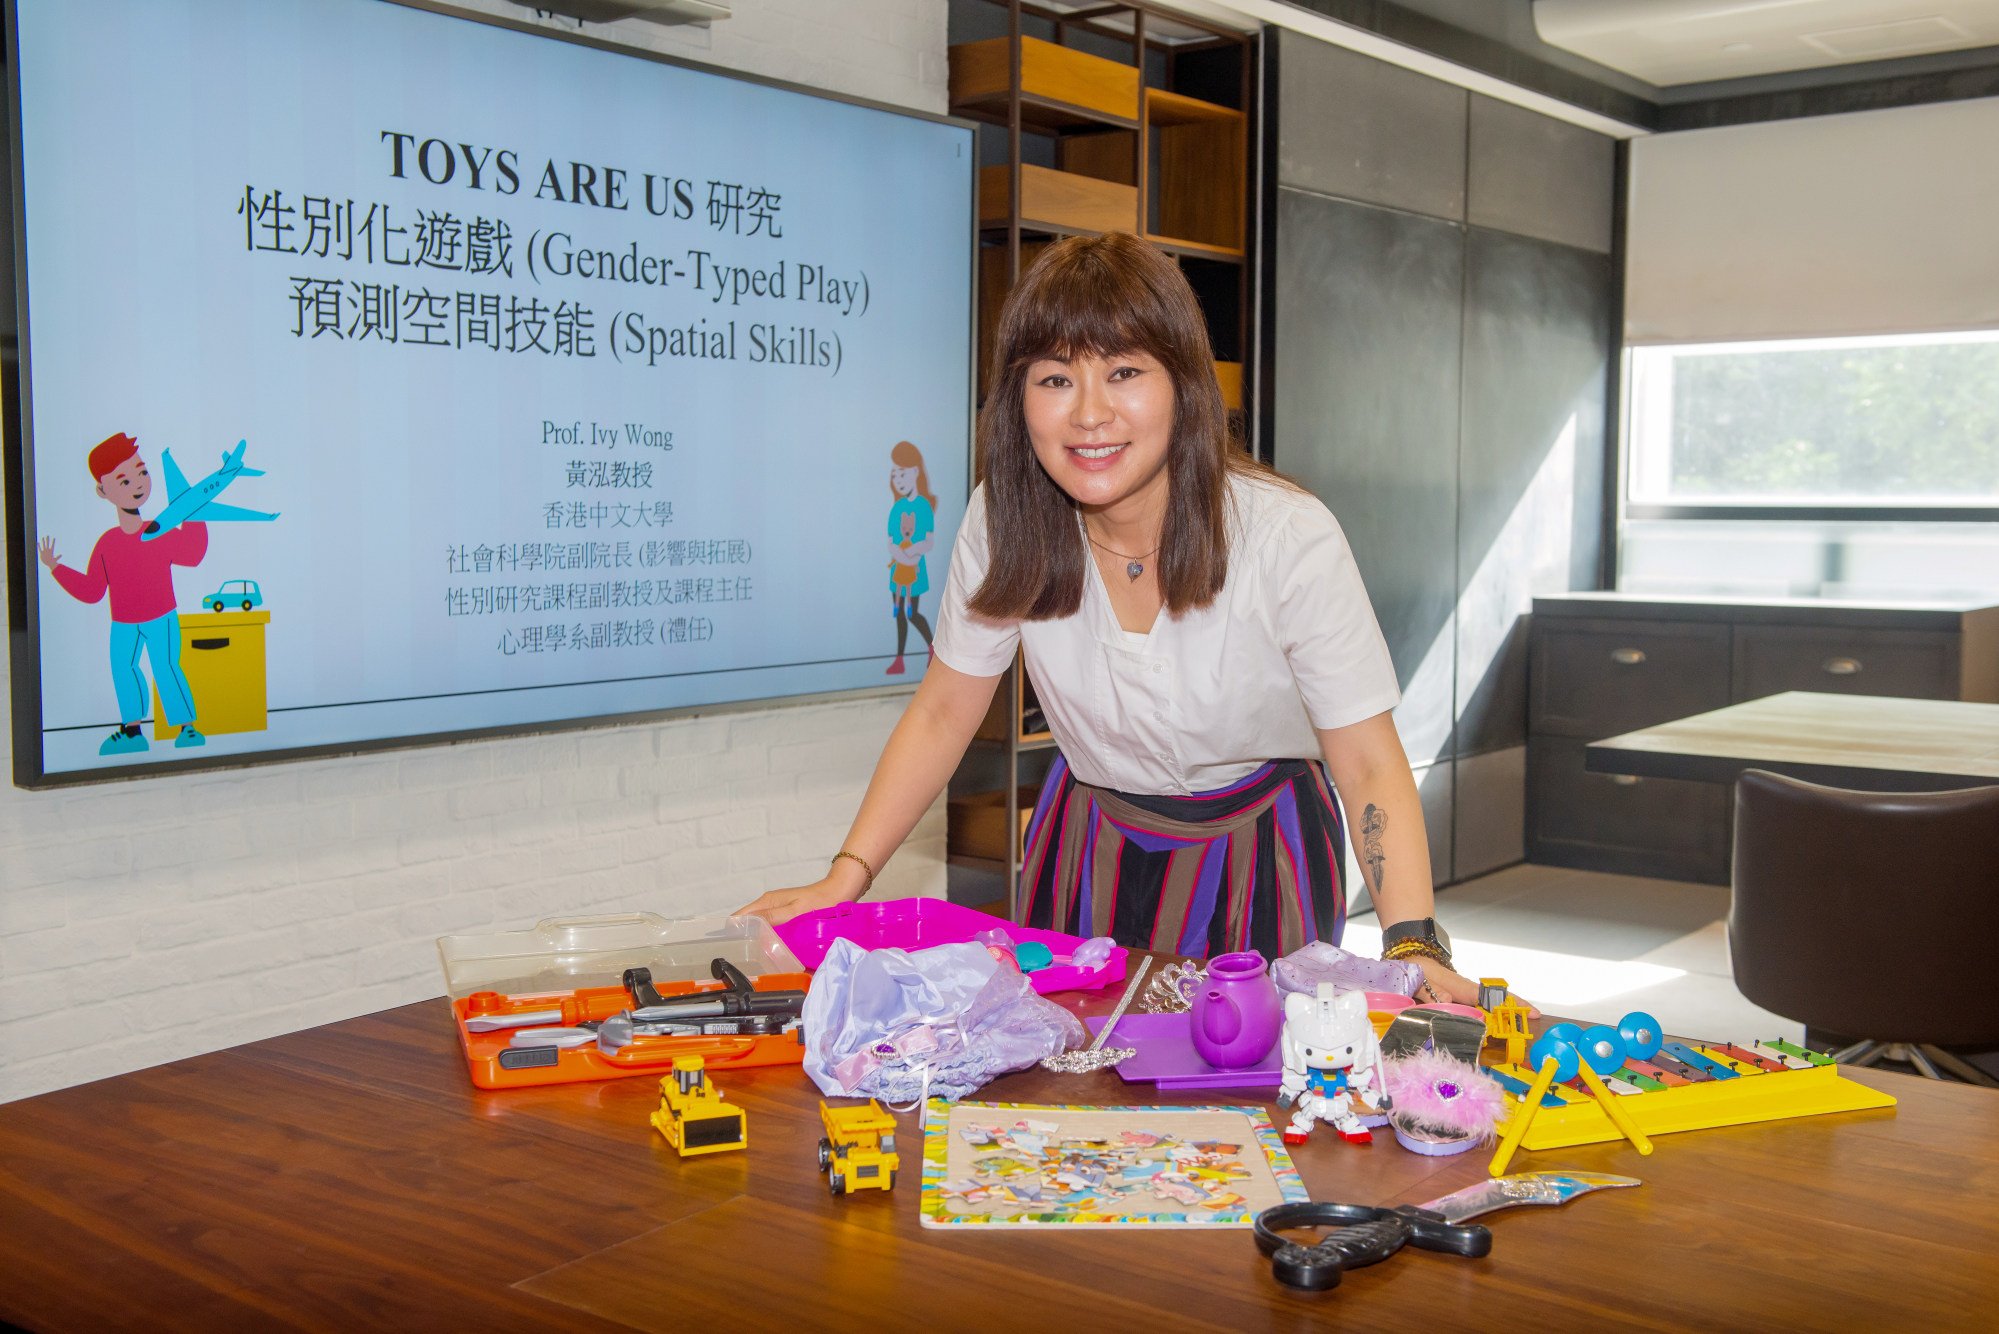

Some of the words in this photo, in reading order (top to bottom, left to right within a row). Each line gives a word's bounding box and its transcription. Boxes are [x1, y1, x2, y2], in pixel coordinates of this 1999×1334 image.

[381, 131, 520, 195] TOYS
[534, 158, 629, 212] ARE
[643, 174, 694, 220] US
[706, 180, 783, 238] 研究
[238, 184, 513, 279] 性別化遊戲
[527, 229, 786, 306] (Gender-Typed
[796, 263, 870, 317] Play)
[289, 276, 596, 357] 預測空間技能
[610, 310, 736, 367] (Spatial
[749, 323, 843, 377] Skills)
[542, 420, 584, 445] Prof.
[591, 422, 618, 450] Ivy
[625, 424, 674, 451] Wong
[565, 460, 653, 488] 黃泓教授
[542, 501, 673, 529] 香港中文大學
[446, 541, 632, 574] 社會科學院副院長
[639, 539, 752, 568] (影響與拓展)
[445, 576, 753, 617] 性別研究課程副教授及課程主任
[497, 618, 654, 656] 心理學系副教授
